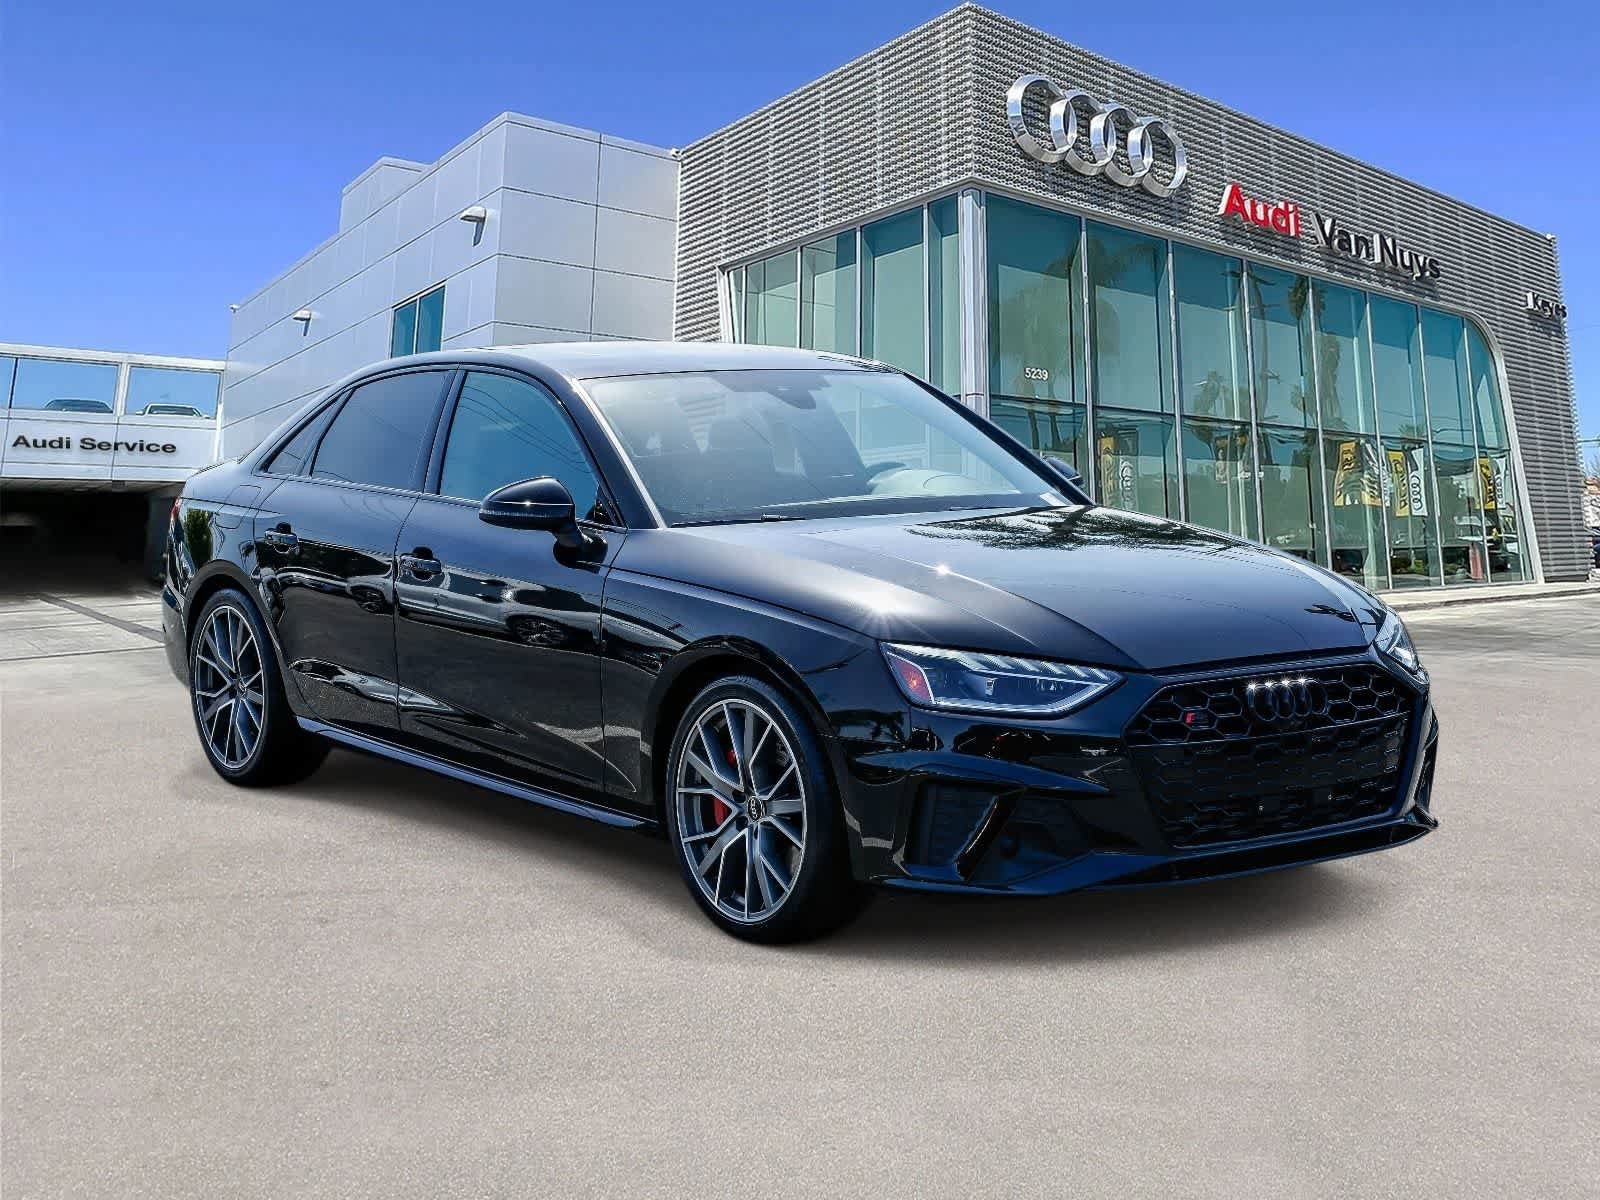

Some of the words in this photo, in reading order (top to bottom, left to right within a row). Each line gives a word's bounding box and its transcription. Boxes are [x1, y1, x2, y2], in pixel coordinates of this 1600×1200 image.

[1218, 181, 1301, 237] Audi
[1311, 212, 1370, 259] Van
[1373, 233, 1441, 280] Nuys
[1025, 367, 1049, 381] 5239
[12, 435, 71, 449] Audi
[79, 437, 177, 453] Service
